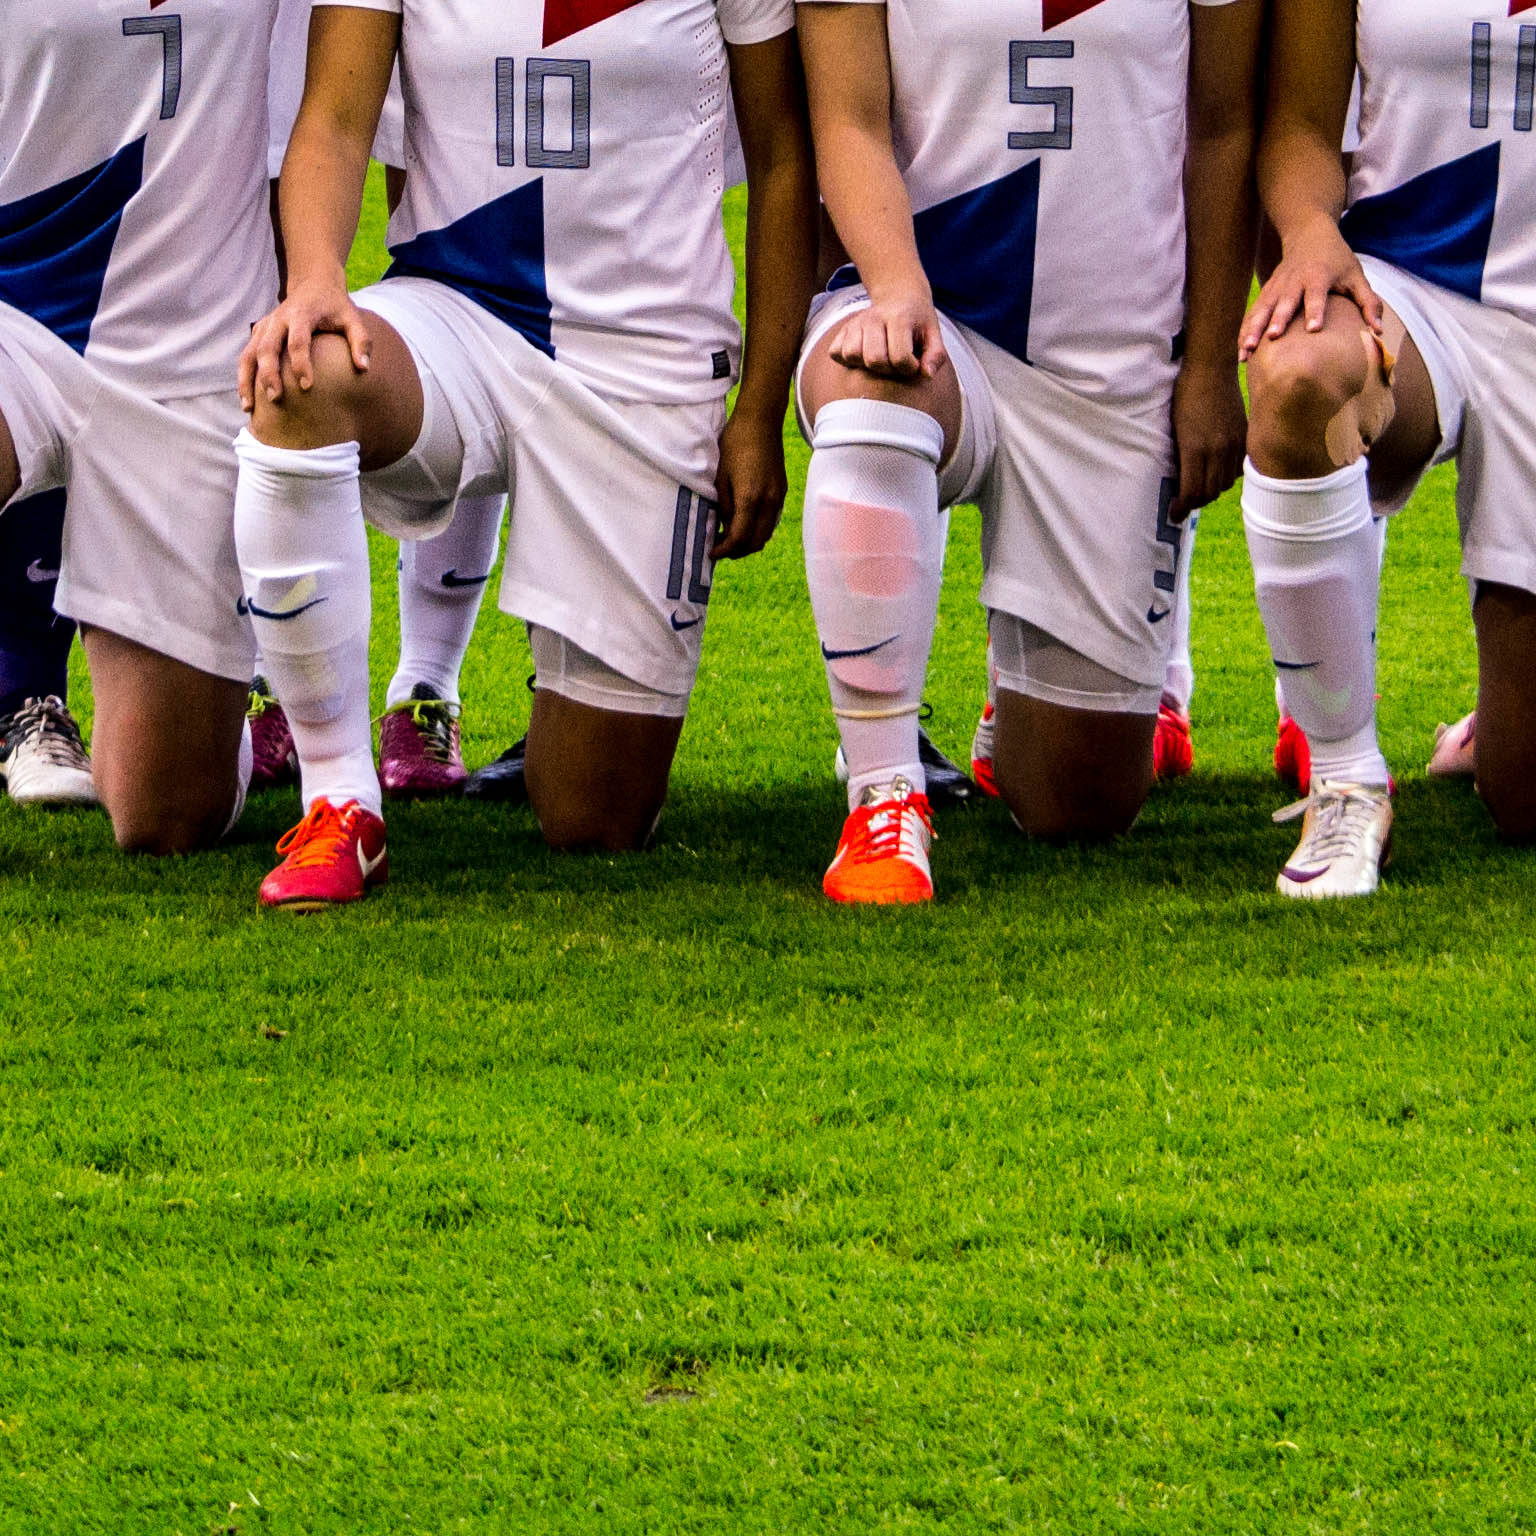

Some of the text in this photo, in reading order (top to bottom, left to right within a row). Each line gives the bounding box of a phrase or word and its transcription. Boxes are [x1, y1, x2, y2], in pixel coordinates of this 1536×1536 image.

[122, 14, 182, 120] 7
[495, 57, 591, 169] 10
[1007, 40, 1074, 150] 5
